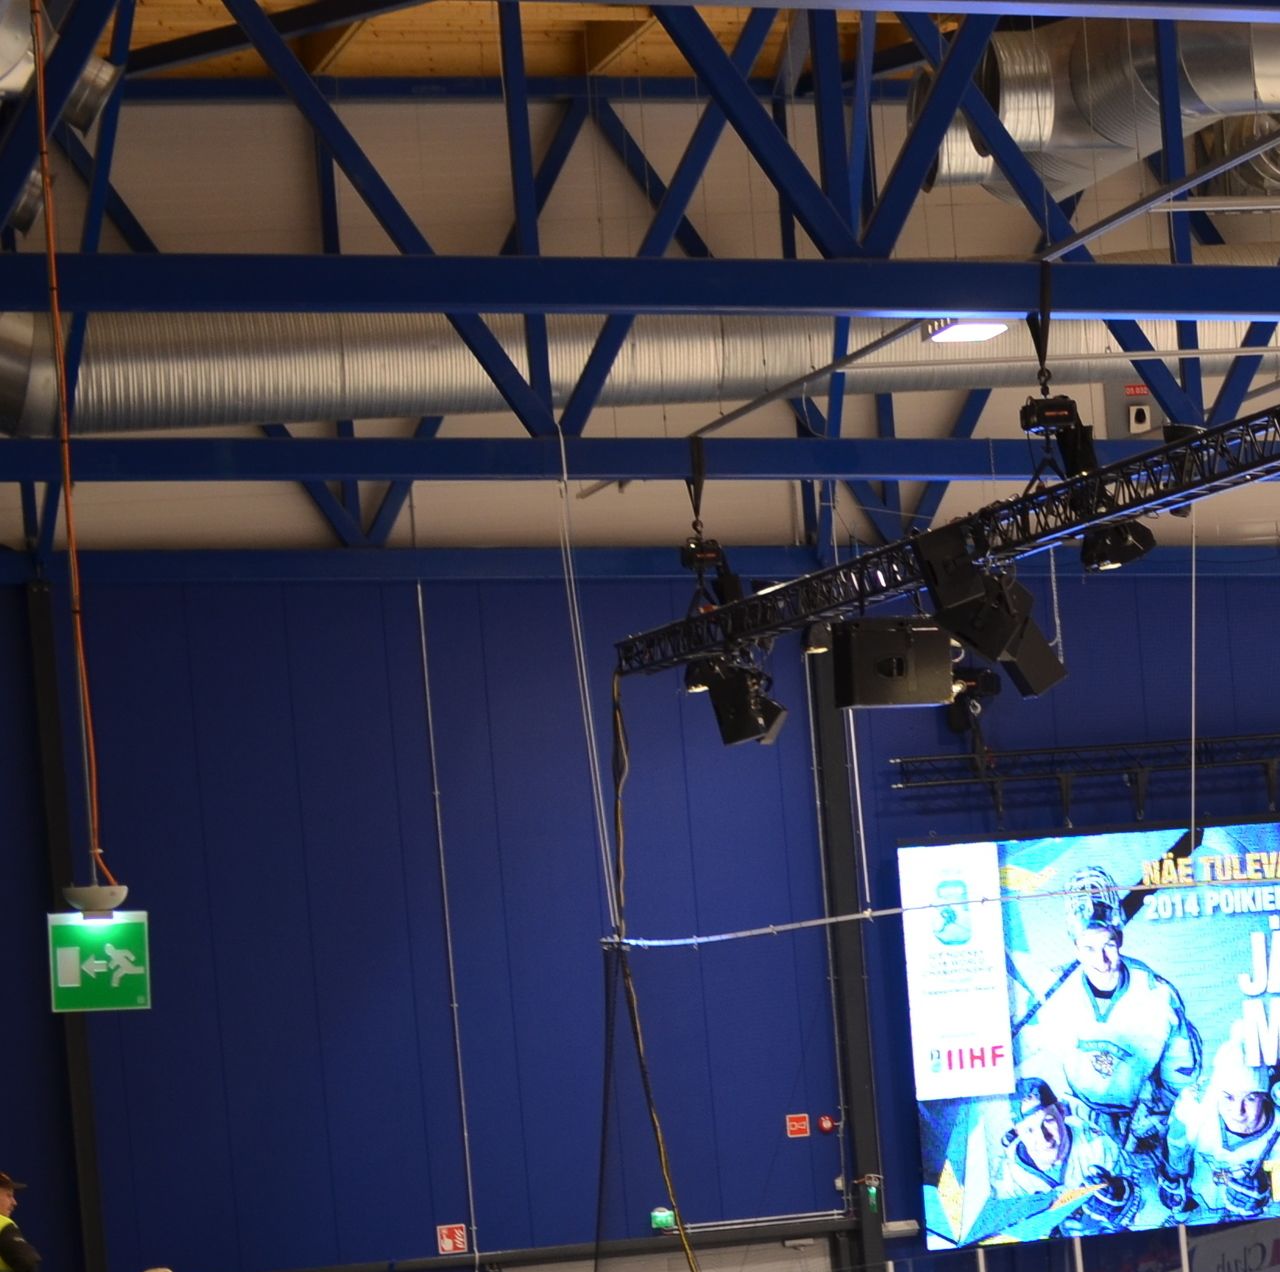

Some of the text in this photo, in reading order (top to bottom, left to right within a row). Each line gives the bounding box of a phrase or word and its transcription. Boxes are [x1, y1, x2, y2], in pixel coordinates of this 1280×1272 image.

[1143, 851, 1194, 886] NÄE
[1143, 894, 1200, 920] 2014
[947, 1045, 1006, 1071] IIHF
